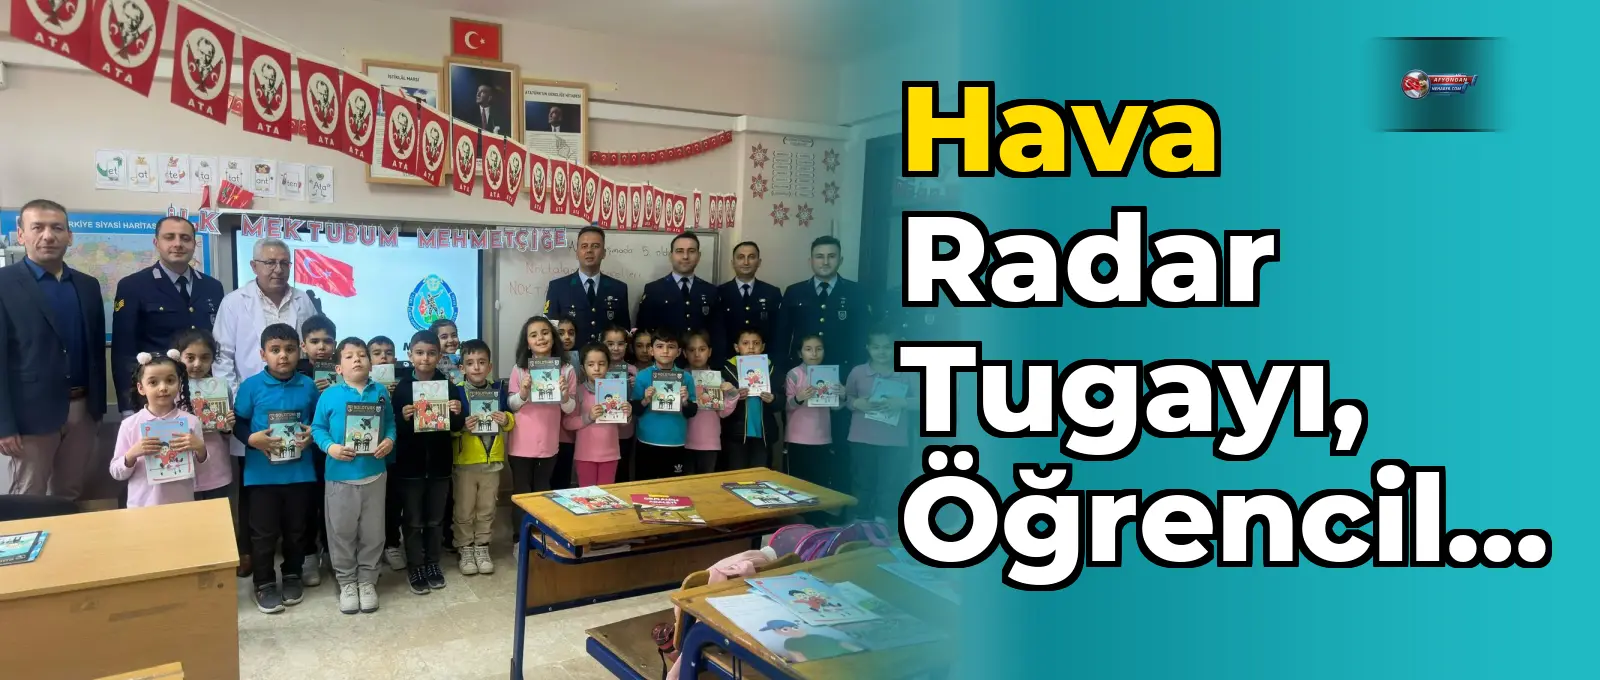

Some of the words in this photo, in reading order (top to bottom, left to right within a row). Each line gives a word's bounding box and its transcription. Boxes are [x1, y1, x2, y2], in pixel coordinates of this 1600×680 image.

[35, 32, 70, 54] ATA
[102, 62, 133, 84] ATA
[188, 98, 213, 116] ATA
[257, 122, 280, 135] ATA
[318, 136, 335, 146] ATA
[349, 146, 364, 158] ATA
[108, 166, 118, 175] et
[392, 160, 408, 171] ATA
[138, 170, 148, 179] at
[168, 169, 178, 179] te
[228, 174, 240, 183] tat
[423, 171, 435, 182] ATA
[255, 177, 269, 185] ant
[313, 181, 327, 191] Ata
[460, 184, 470, 192] ATA
[68, 221, 93, 229] RKİYE
[95, 221, 121, 229] SİYASİ
[123, 222, 157, 230] HARİTAS
[241, 213, 399, 247] MEKTUBUM
[417, 228, 567, 252] MEHMETÇİĞE
